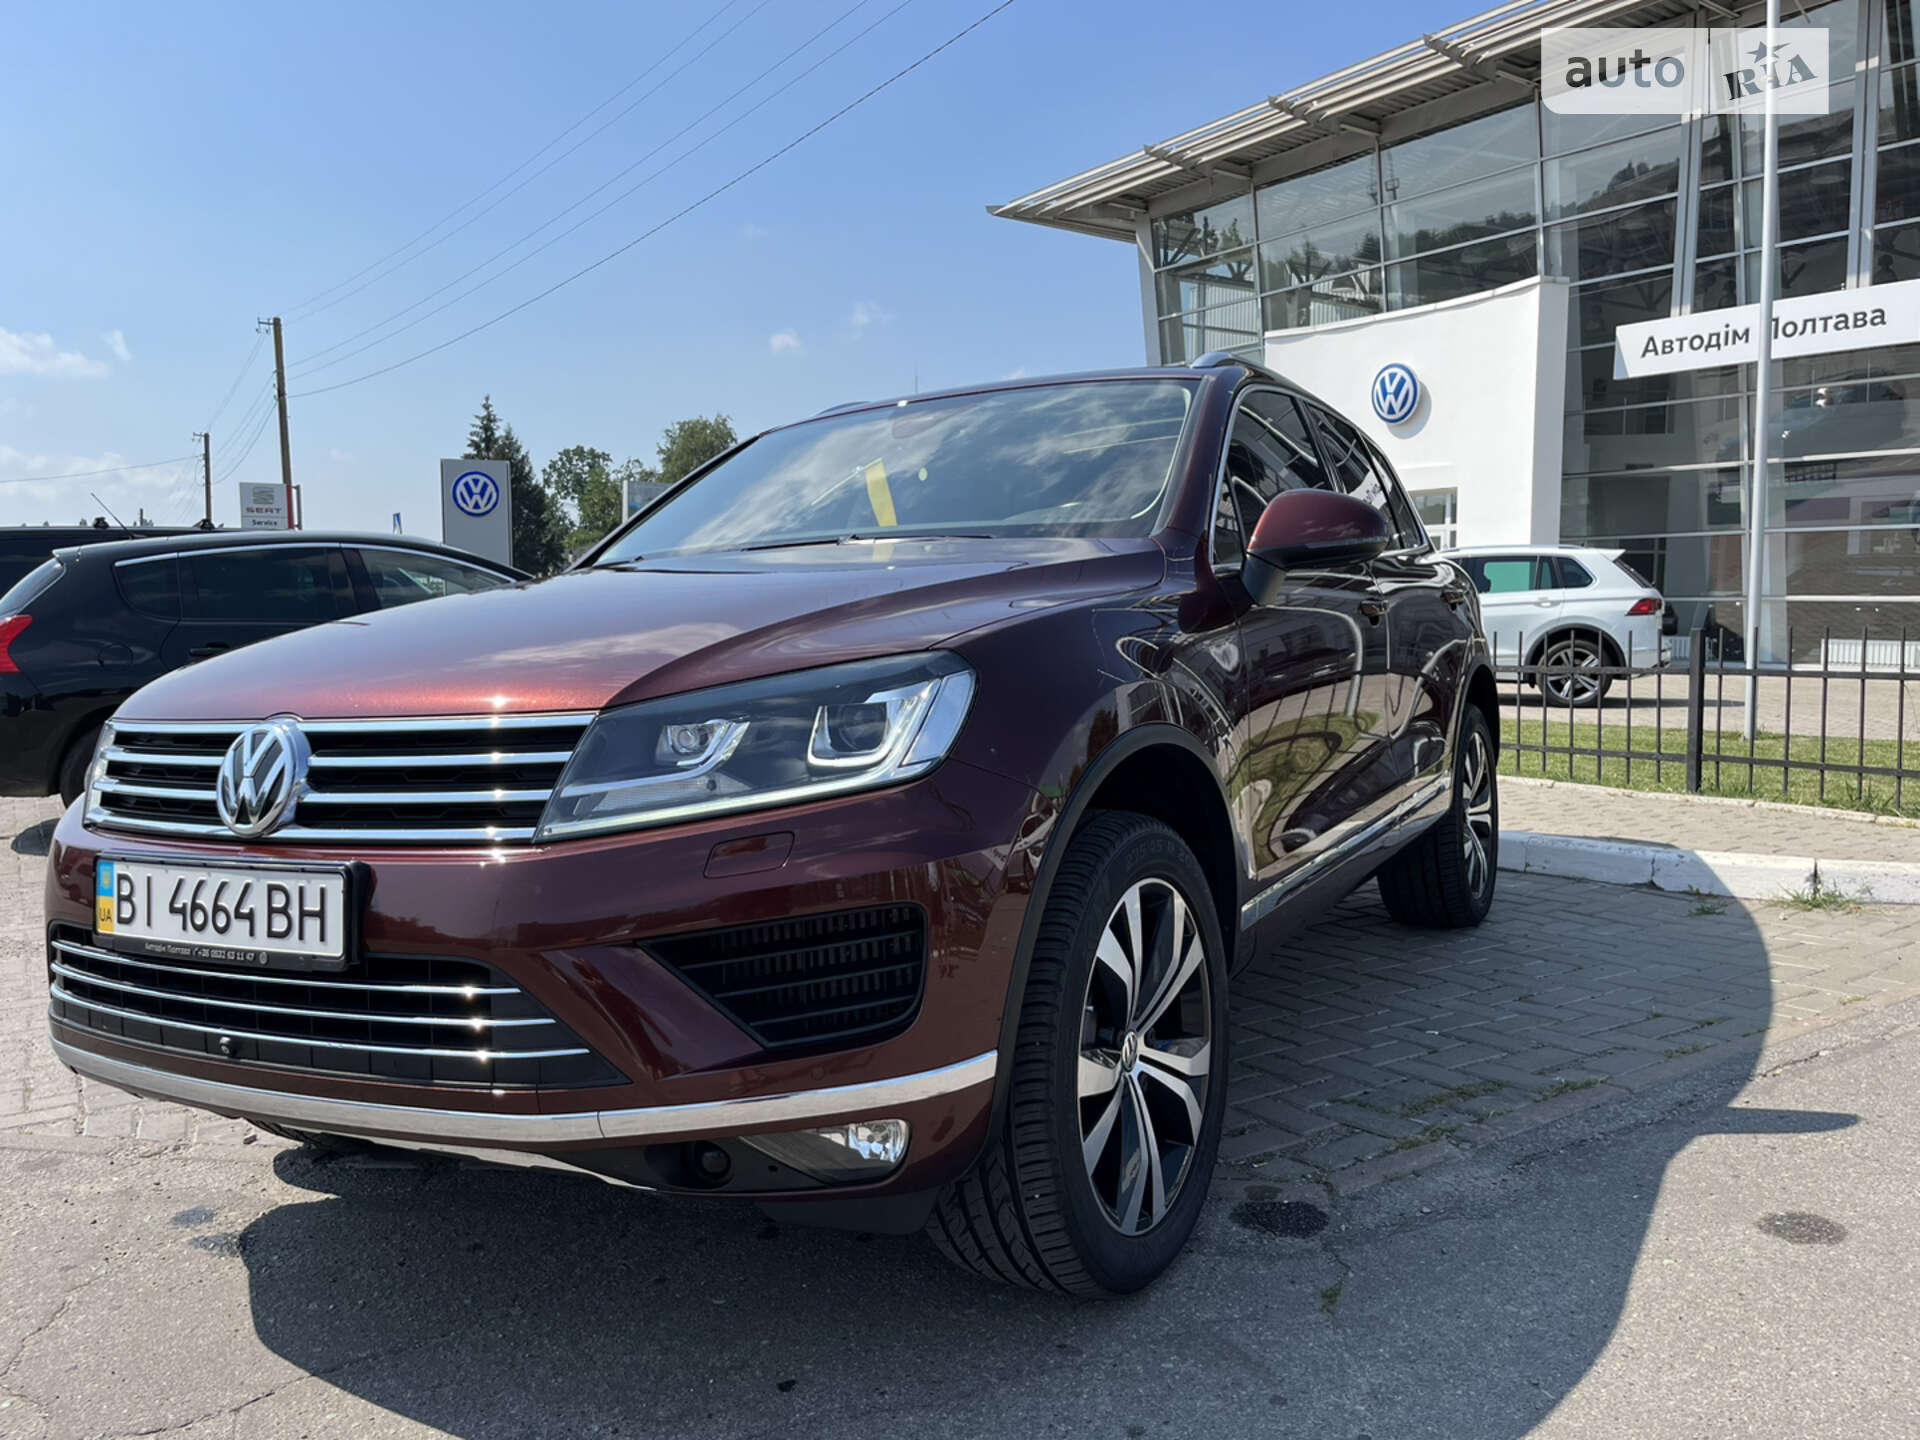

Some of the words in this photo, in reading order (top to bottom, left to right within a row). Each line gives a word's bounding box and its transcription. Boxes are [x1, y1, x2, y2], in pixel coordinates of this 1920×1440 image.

[1641, 323, 1750, 358] Автодім
[99, 907, 112, 922] UA
[168, 877, 255, 937] 4664
